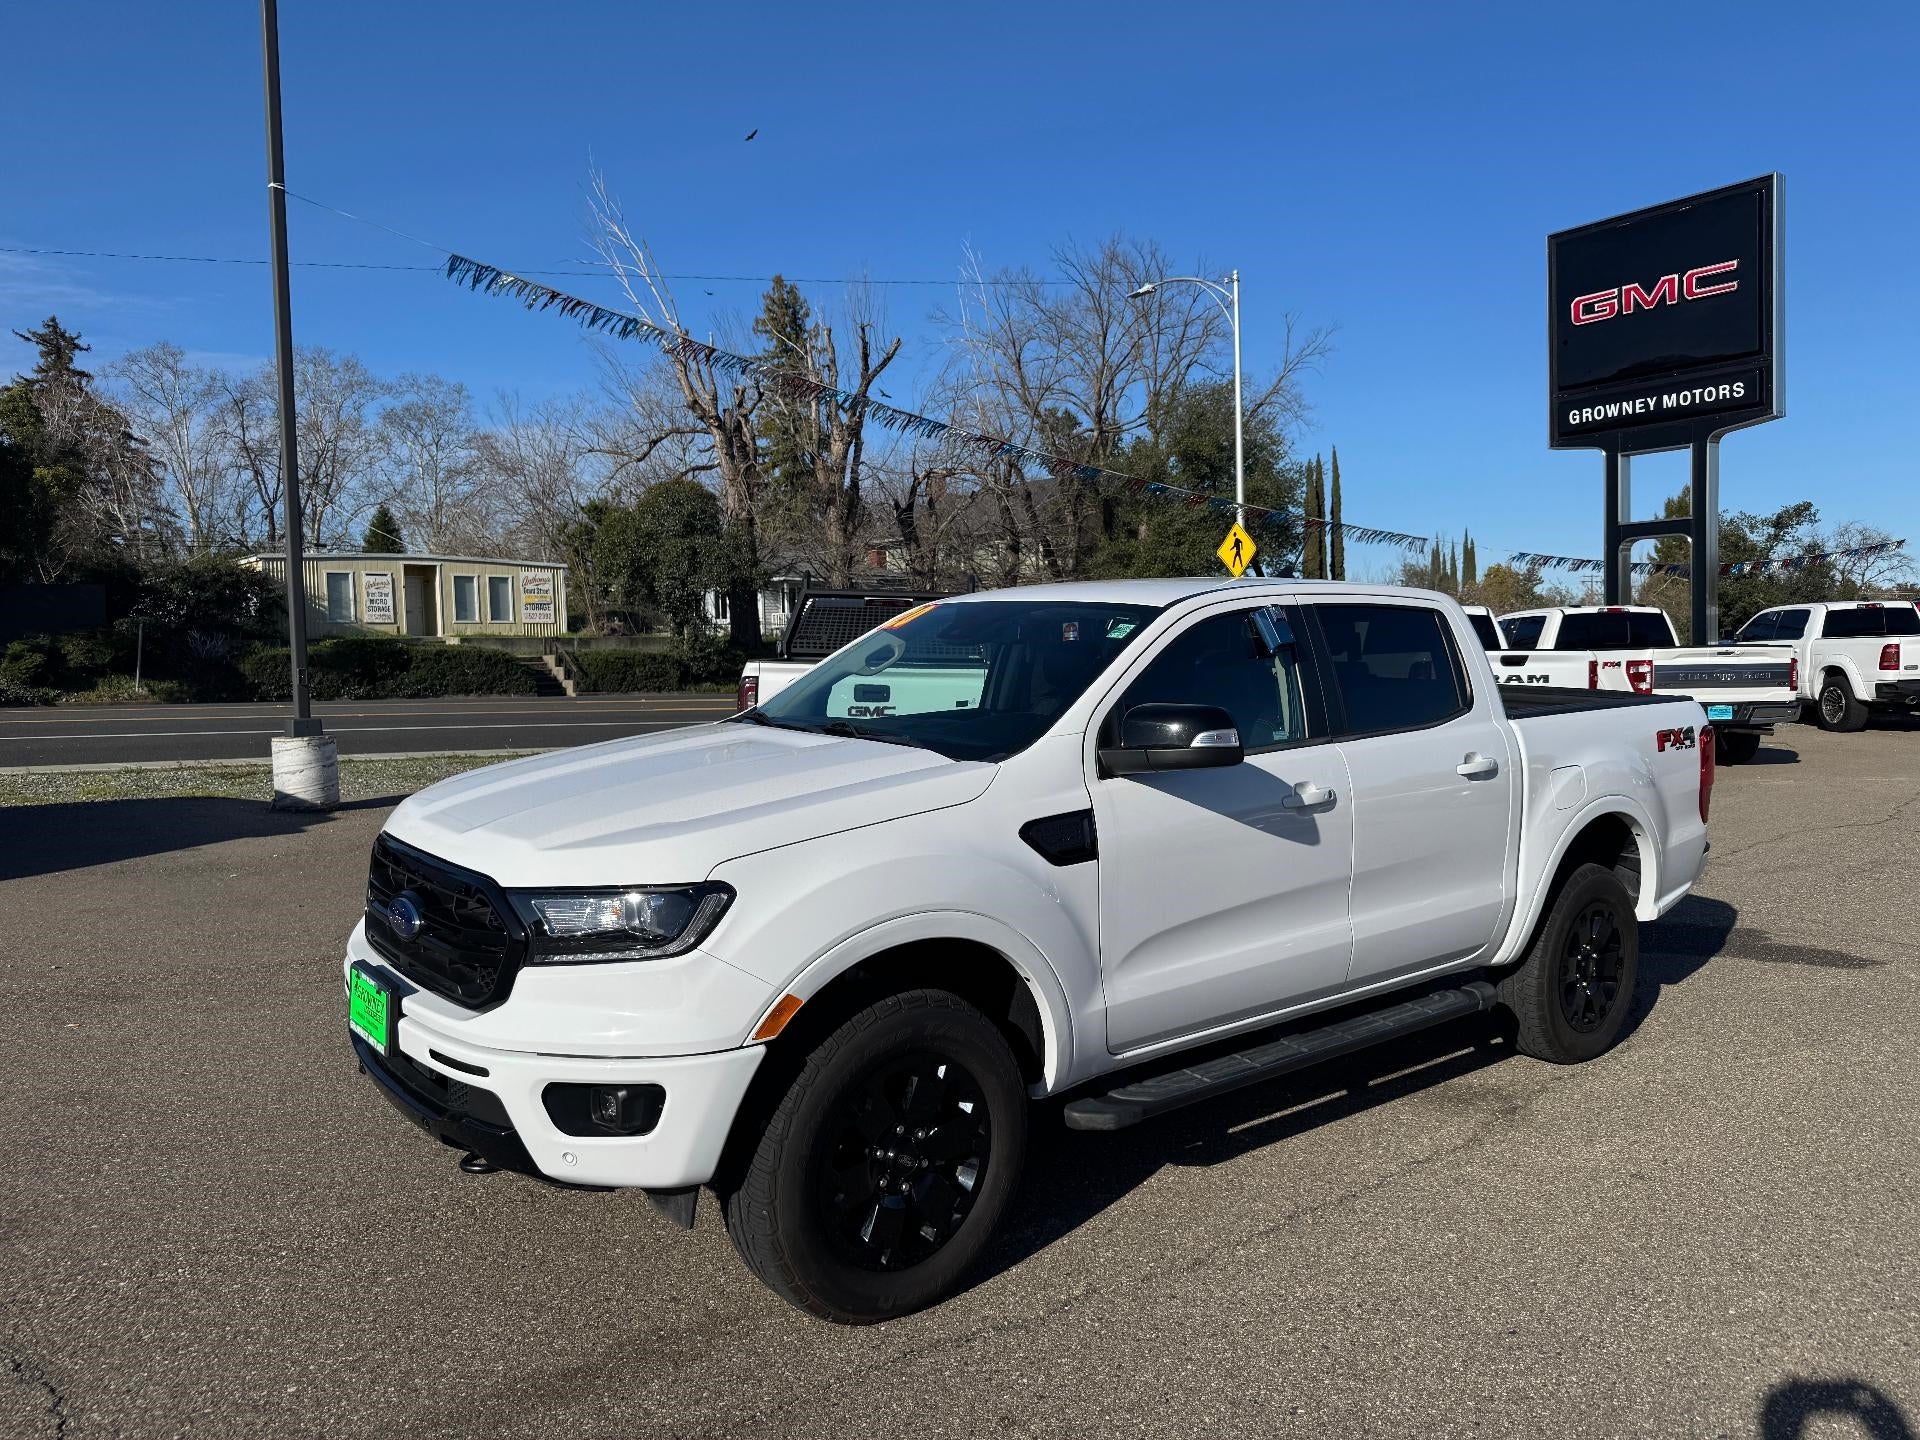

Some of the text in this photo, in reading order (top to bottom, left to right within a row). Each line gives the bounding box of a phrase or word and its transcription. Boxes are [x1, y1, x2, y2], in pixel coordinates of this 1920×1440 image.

[1571, 258, 1739, 325] GMC
[1568, 382, 1745, 424] GROWNEY MOTORS
[369, 598, 388, 606] MICRO
[524, 602, 552, 611] STORAGE
[367, 605, 391, 613] STORAGE
[1601, 661, 1622, 670] FX4
[848, 706, 897, 718] GMC
[1656, 725, 1696, 753] FX4
